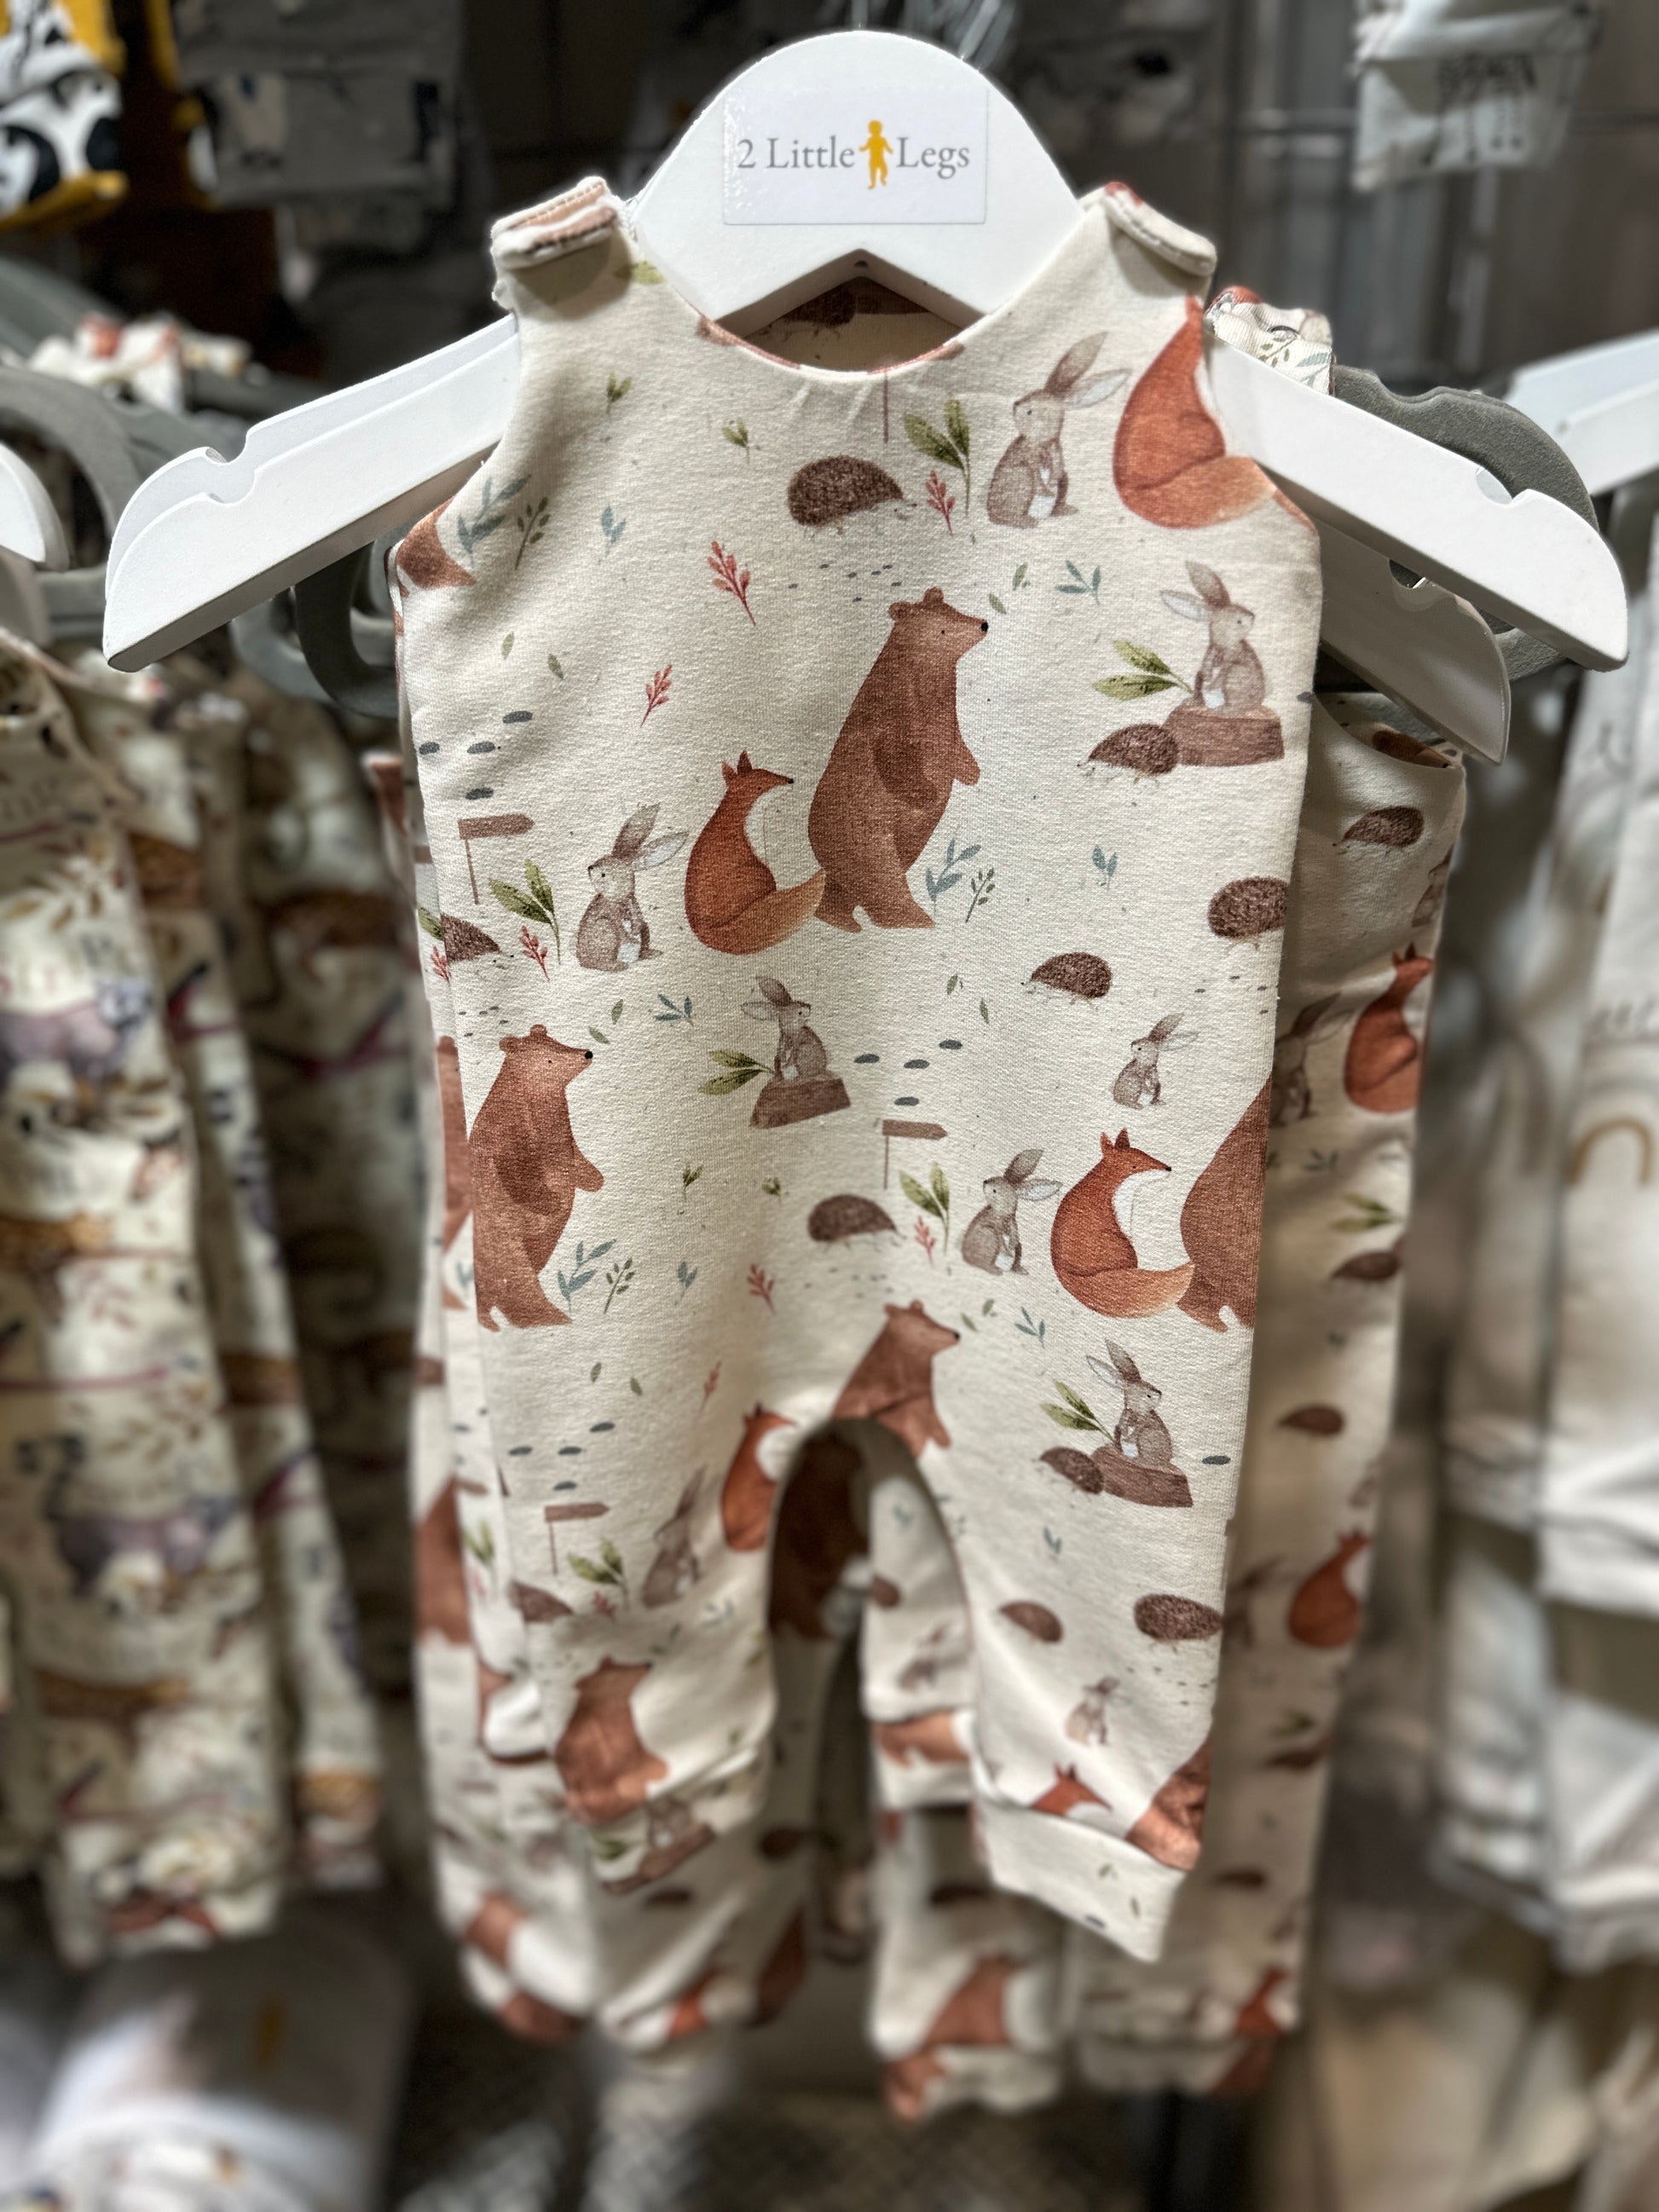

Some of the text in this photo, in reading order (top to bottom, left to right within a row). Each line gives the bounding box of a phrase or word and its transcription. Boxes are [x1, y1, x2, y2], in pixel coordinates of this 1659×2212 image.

[737, 135, 970, 180] 2 Little Legs
